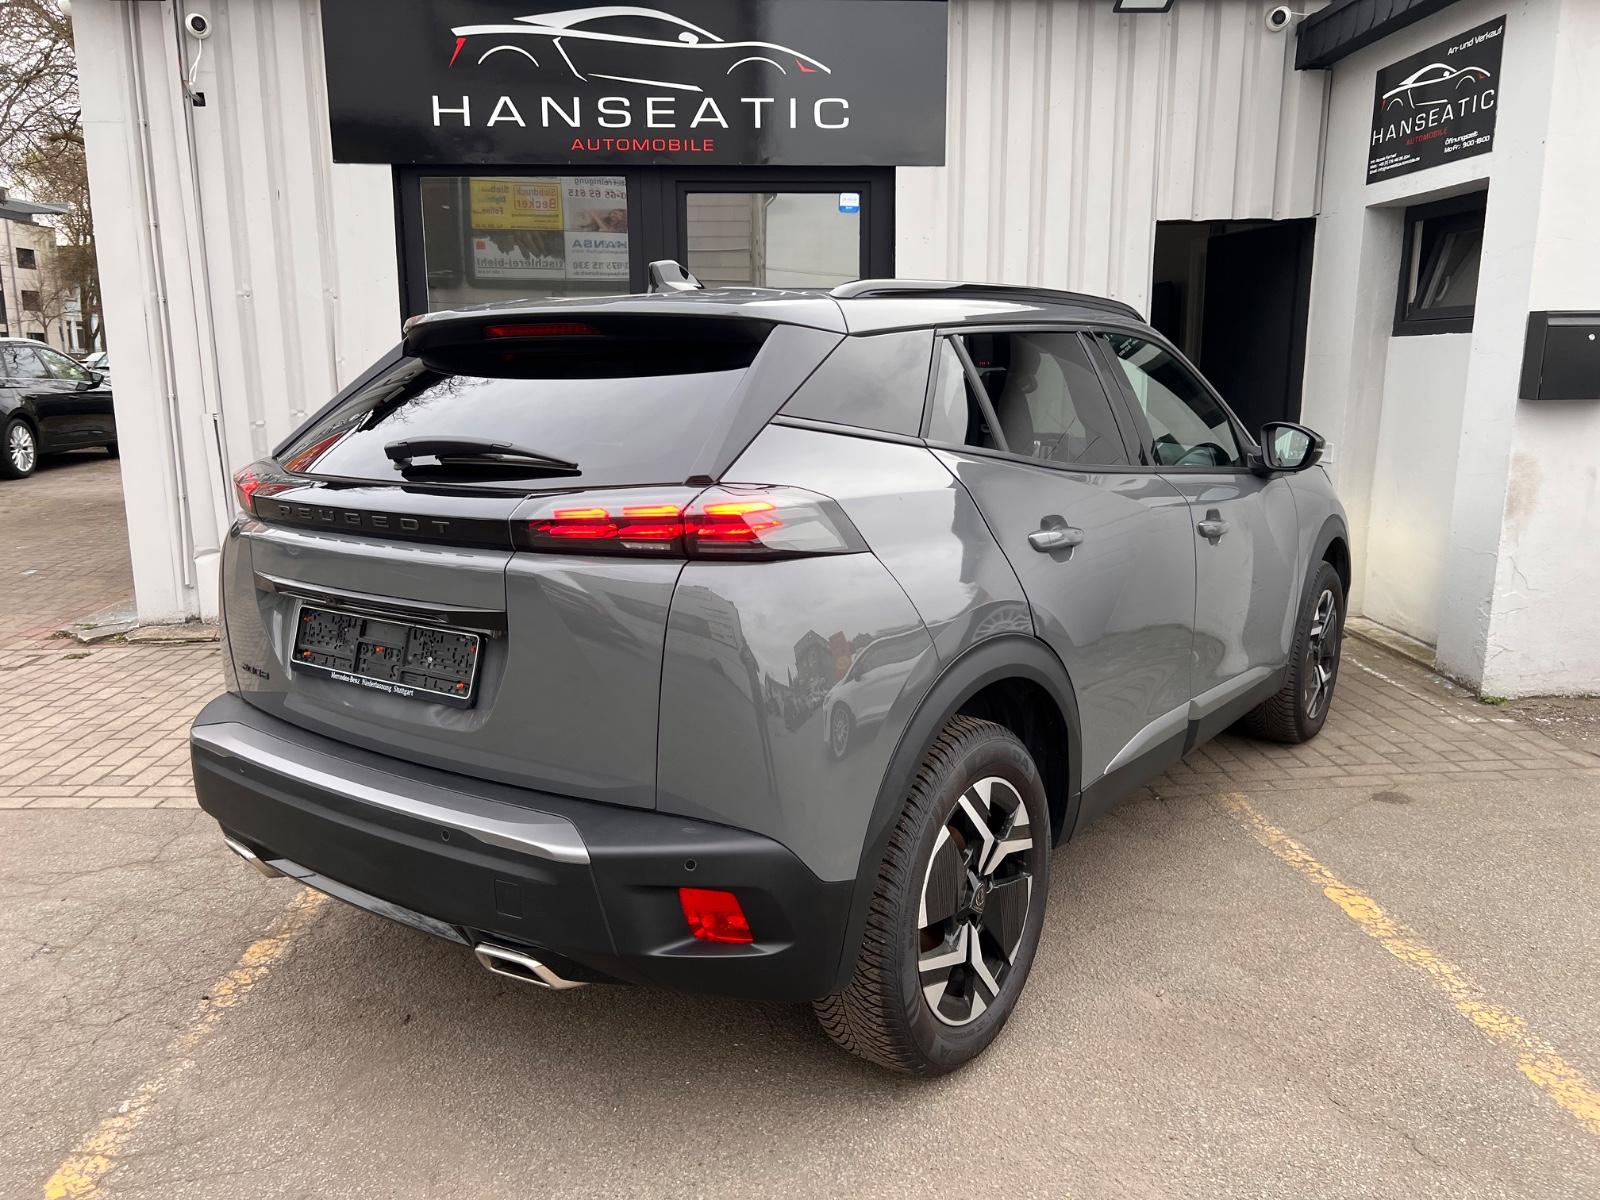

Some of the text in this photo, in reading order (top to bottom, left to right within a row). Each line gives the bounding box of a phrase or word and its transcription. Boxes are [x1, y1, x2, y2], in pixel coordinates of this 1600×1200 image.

[1459, 37, 1474, 51] und
[1474, 25, 1503, 44] Verkauf
[431, 95, 850, 129] HANSEATIC
[1372, 89, 1494, 146] HANSEATIC
[570, 137, 715, 152] AUTOMOBILE
[1406, 128, 1449, 146] AUTOMOBILE
[277, 504, 451, 534] PEUGEOT
[330, 672, 360, 685] Mercedes-Benz
[393, 685, 414, 697] Stuttgart
